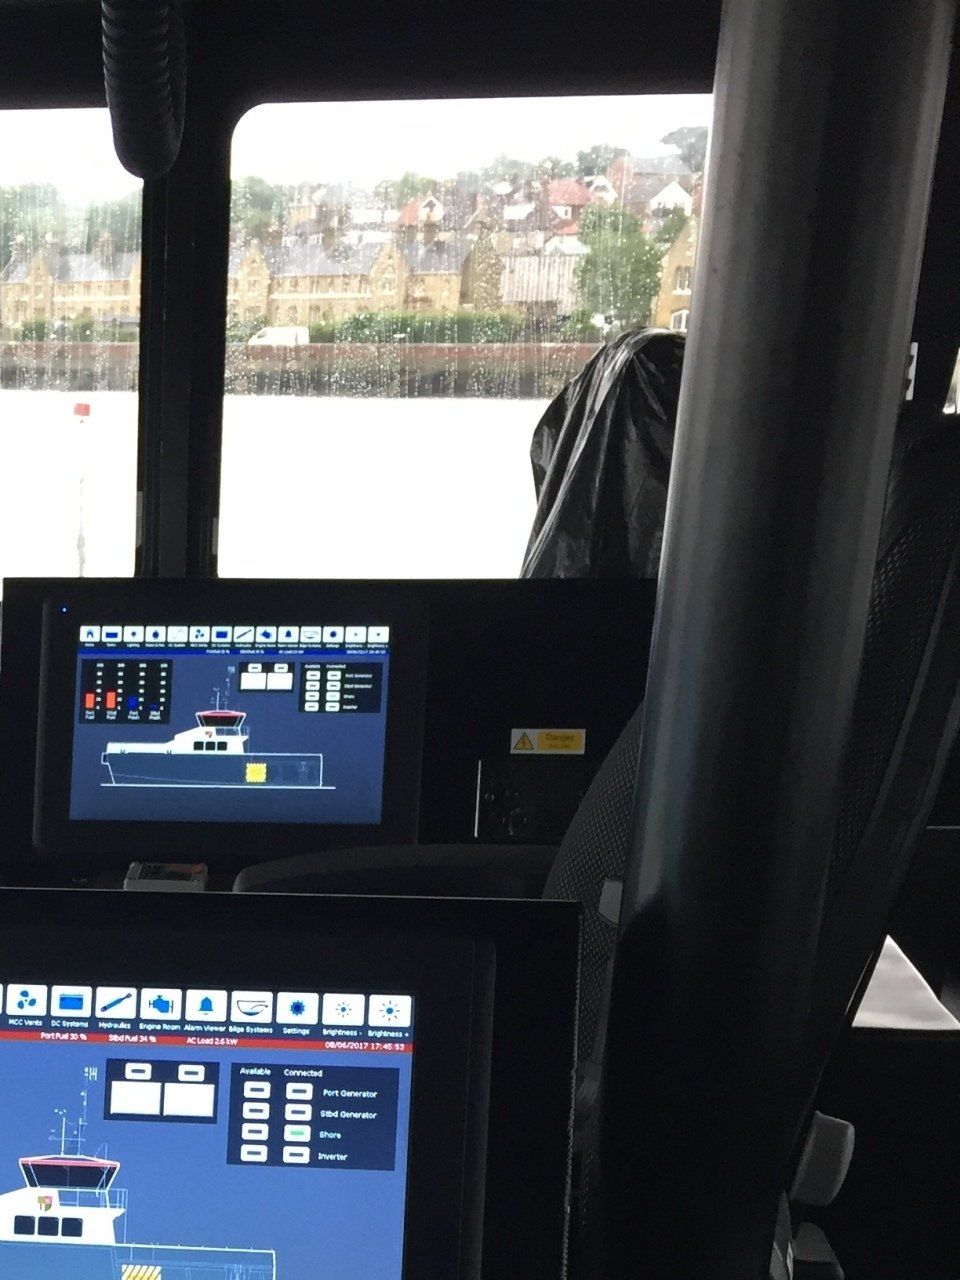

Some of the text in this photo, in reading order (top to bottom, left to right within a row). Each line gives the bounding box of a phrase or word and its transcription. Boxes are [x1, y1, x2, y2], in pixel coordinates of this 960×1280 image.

[546, 732, 575, 743] Danger
[62, 1020, 88, 1028] Systems
[98, 1022, 131, 1030] Hydraulics
[140, 1023, 162, 1031] Engine
[56, 1032, 69, 1040] Fuel
[323, 1028, 358, 1036] Brightness
[368, 1030, 402, 1038] Brightness
[226, 1038, 238, 1046] kW
[325, 1042, 368, 1050] 08/06/2017
[240, 1068, 272, 1076] Available
[284, 1069, 323, 1078] Connected
[322, 1088, 378, 1098] Port Generator
[320, 1110, 377, 1120] Stbd Generator
[319, 1131, 341, 1139] Shore
[318, 1152, 348, 1161] Inverter
